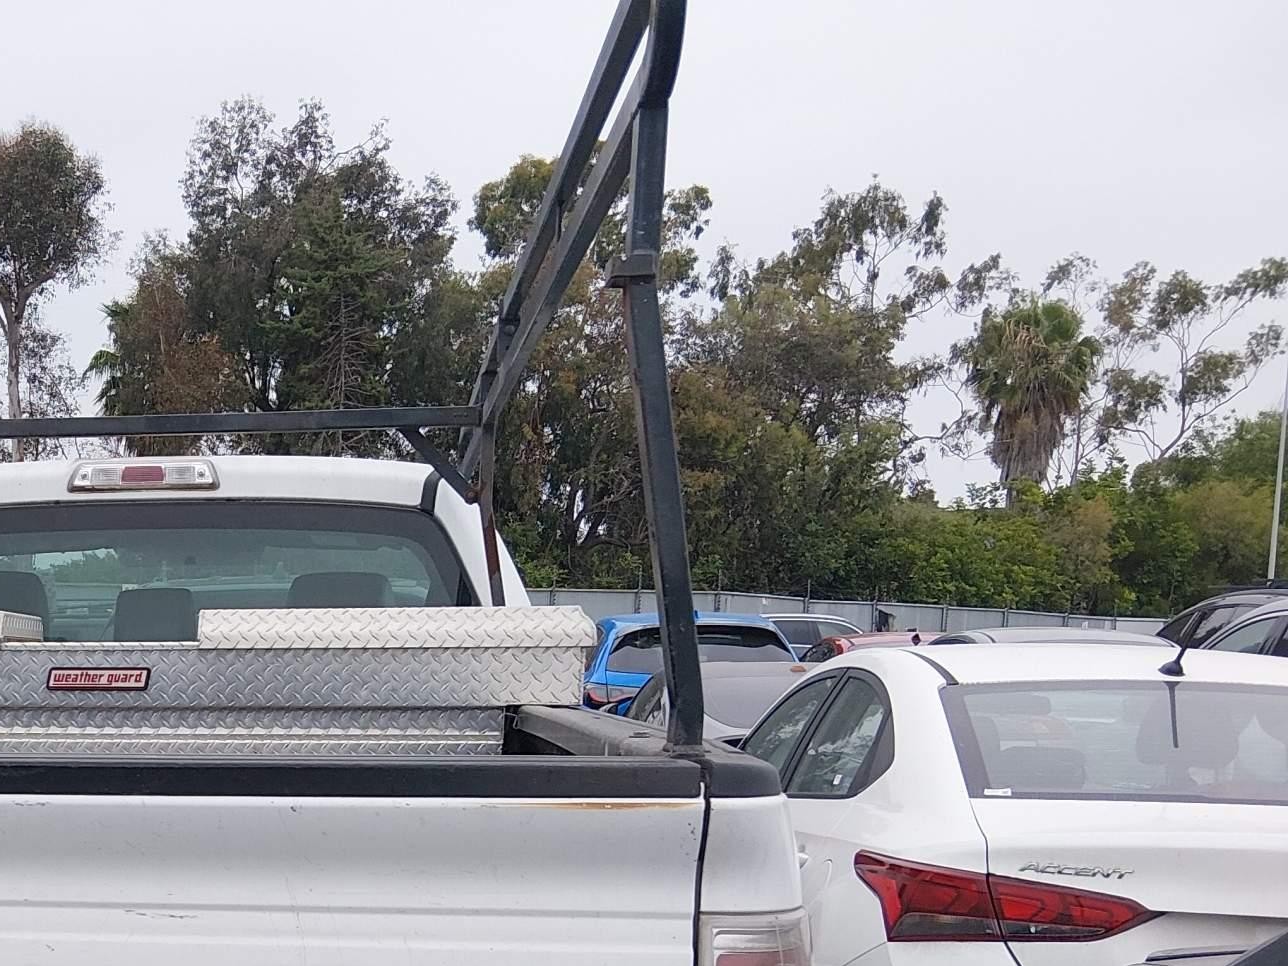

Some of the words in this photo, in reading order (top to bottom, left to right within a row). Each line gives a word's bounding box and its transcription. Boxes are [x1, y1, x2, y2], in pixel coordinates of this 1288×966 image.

[53, 671, 105, 684] weather
[106, 671, 143, 685] guard
[1018, 861, 1134, 879] ACCENT
